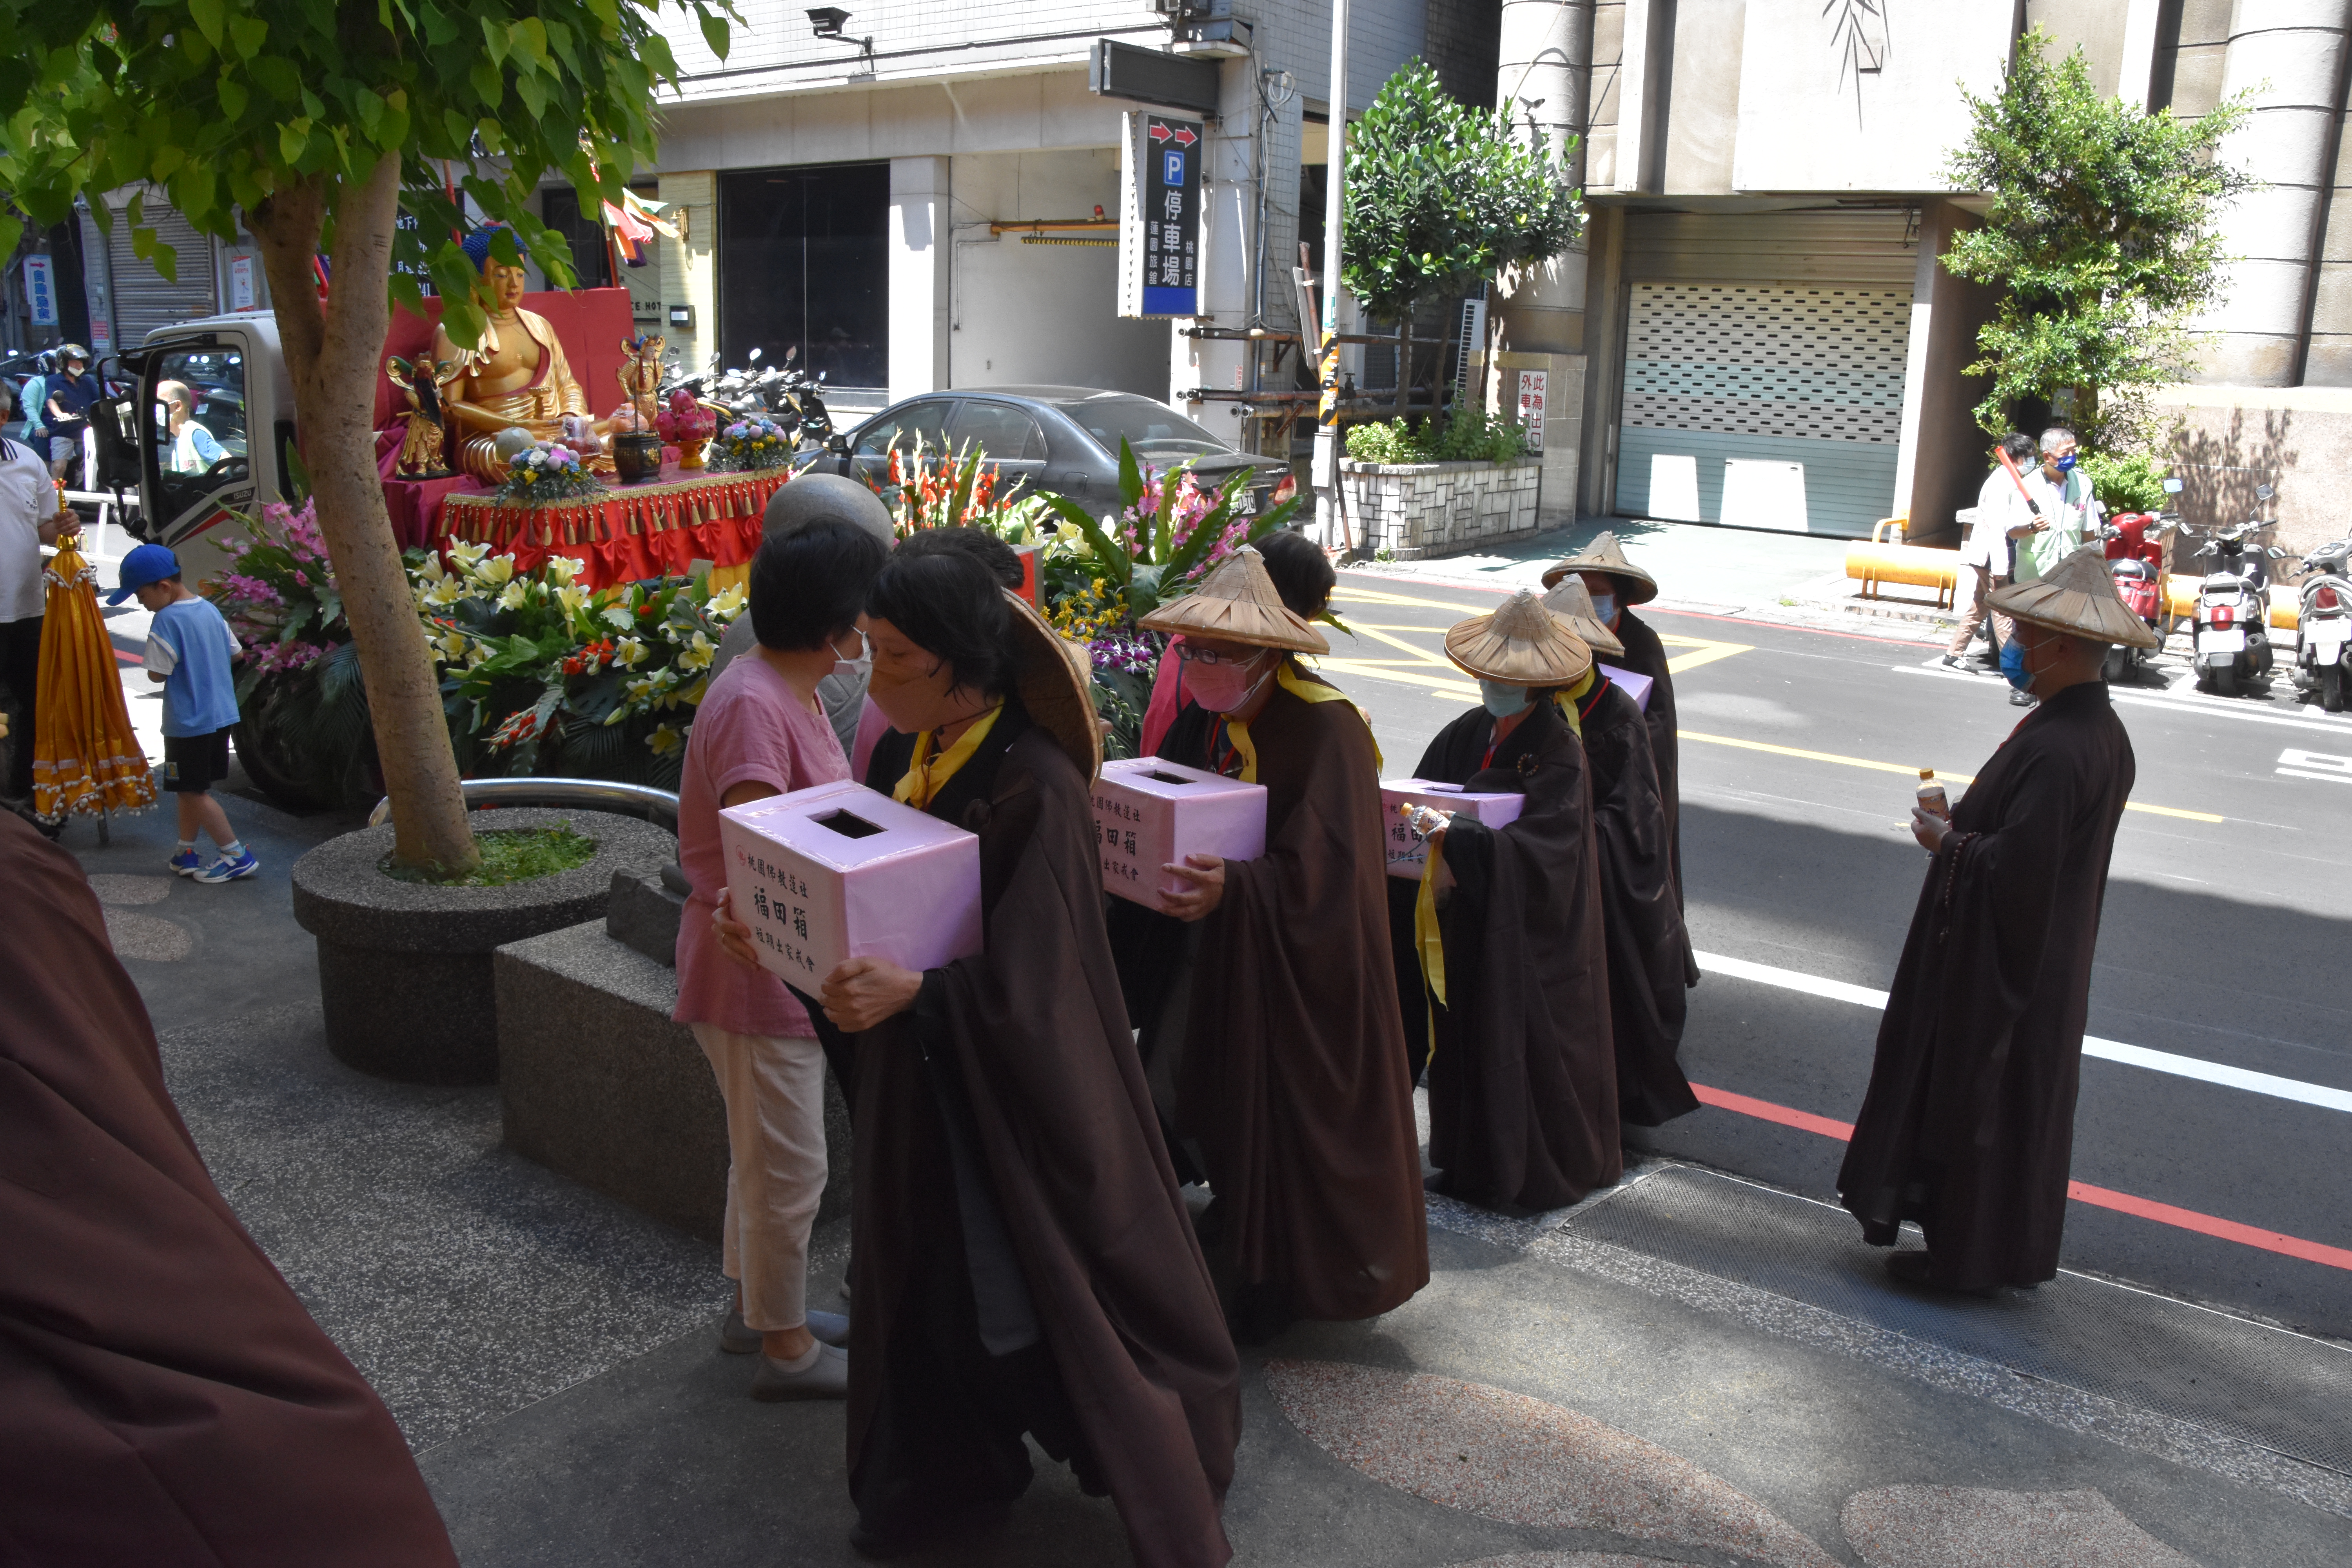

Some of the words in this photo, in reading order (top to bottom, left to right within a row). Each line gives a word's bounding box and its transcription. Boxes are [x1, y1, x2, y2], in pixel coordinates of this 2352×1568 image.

[1168, 156, 1181, 180] P
[1162, 190, 1182, 286] 停車場
[1185, 240, 1194, 287] 桃園店
[34, 270, 50, 319] 自助洗衣
[417, 283, 431, 297] 41
[1531, 374, 1544, 448] 此為出口
[234, 489, 252, 500] ISUZU
[748, 852, 808, 899] 桃園佛教蓮社
[754, 885, 808, 941] 福田箱
